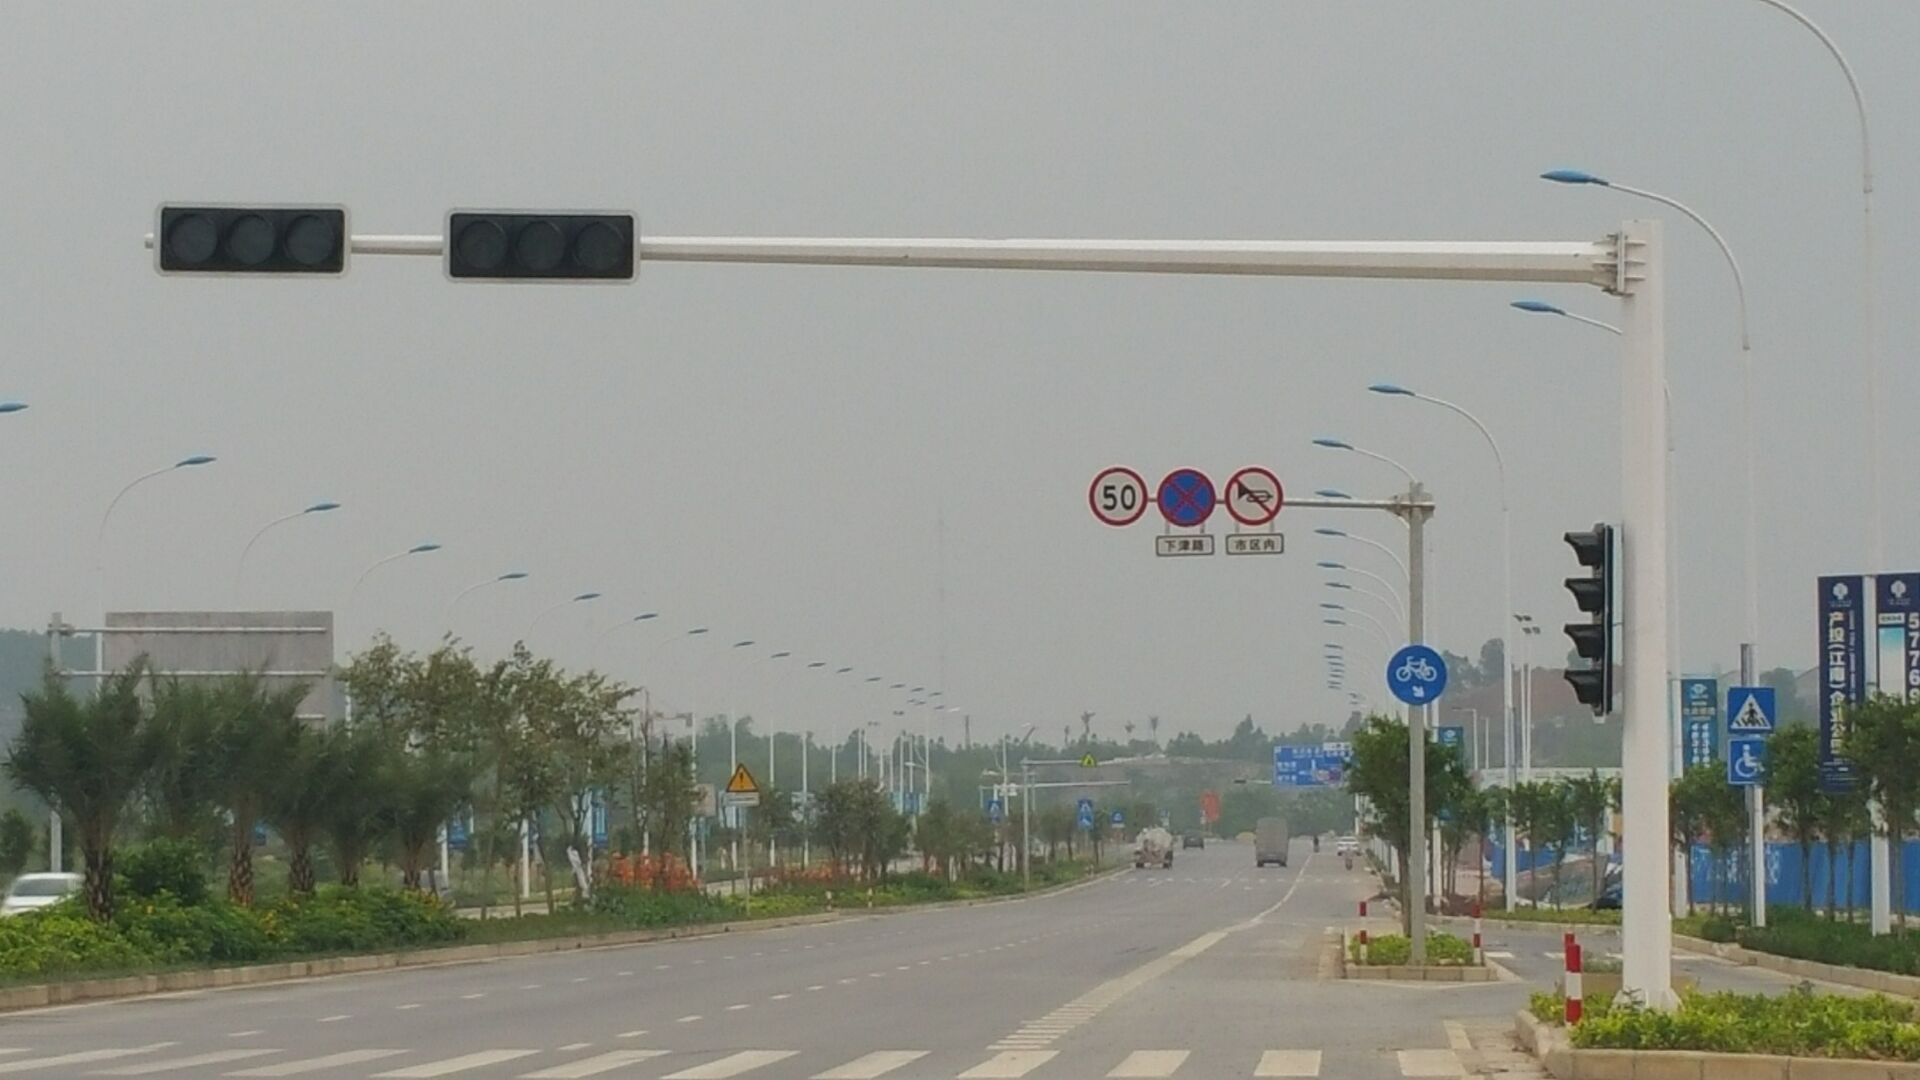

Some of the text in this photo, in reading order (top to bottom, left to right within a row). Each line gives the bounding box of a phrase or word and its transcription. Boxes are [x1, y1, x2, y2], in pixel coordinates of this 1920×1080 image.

[1103, 484, 1136, 511] 50
[1235, 538, 1276, 551] 市区内
